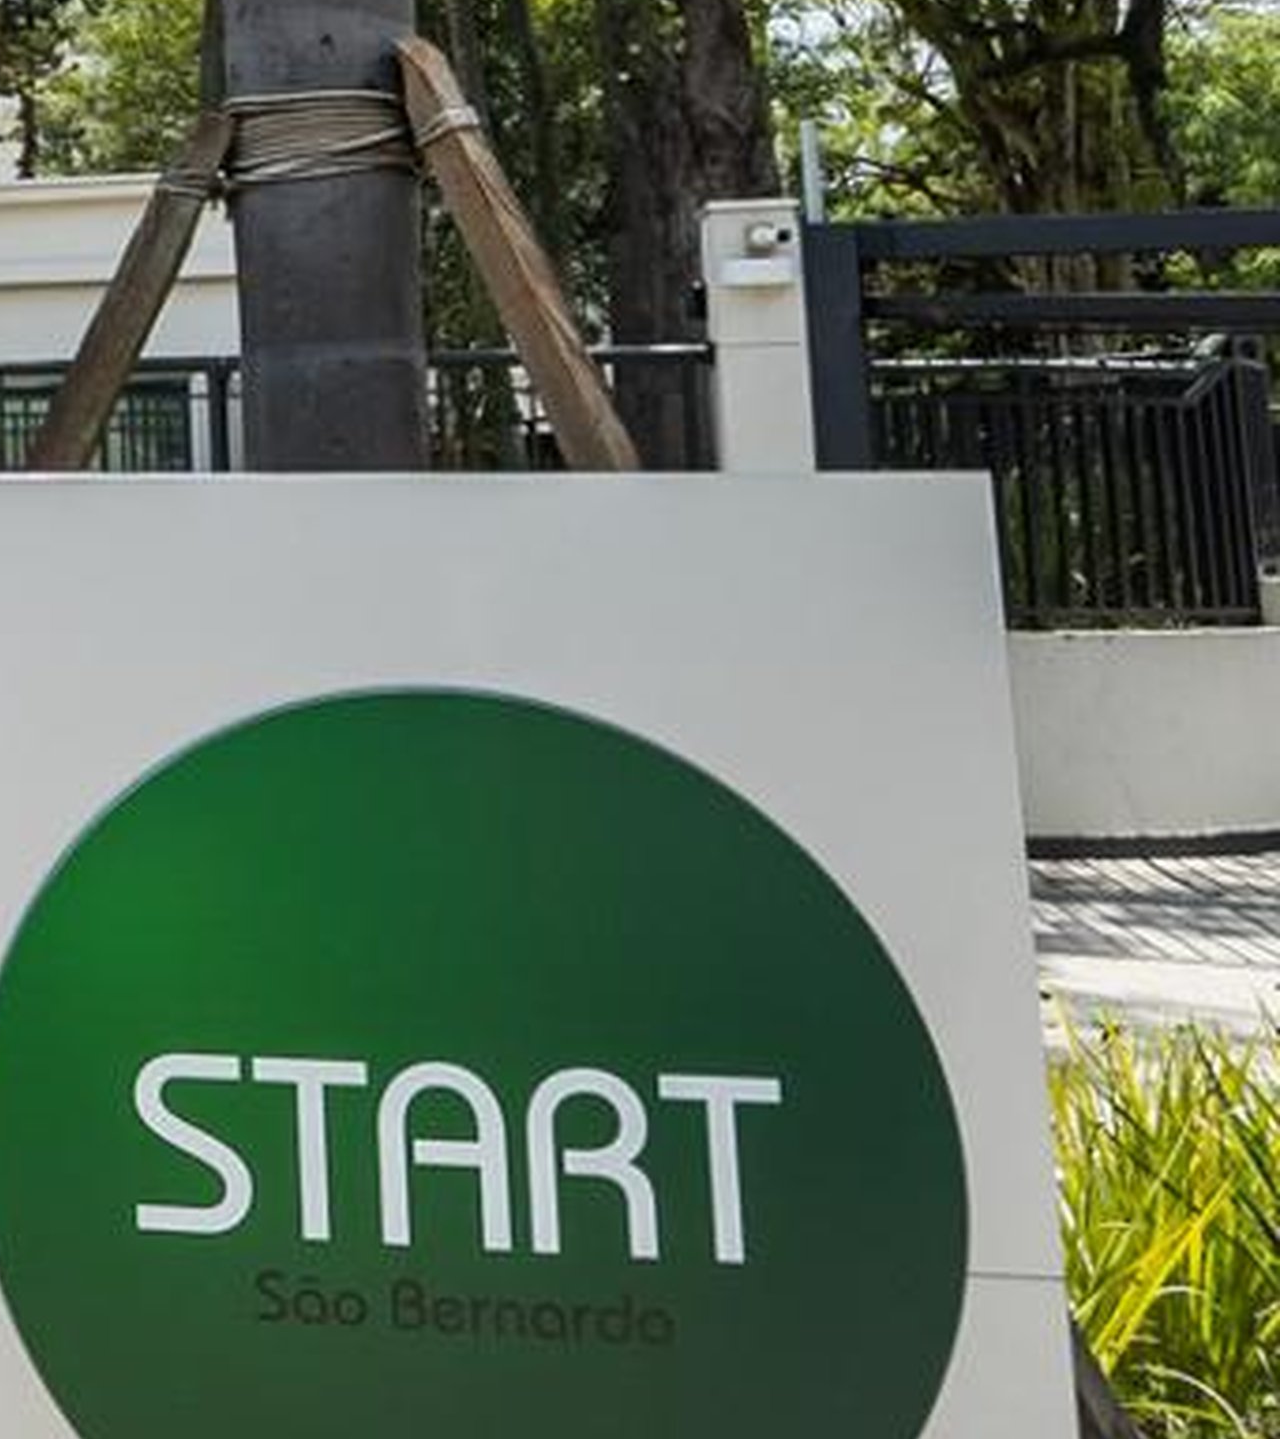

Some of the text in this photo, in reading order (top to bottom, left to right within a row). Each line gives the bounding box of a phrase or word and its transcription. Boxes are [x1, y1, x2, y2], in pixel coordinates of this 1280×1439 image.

[133, 1052, 782, 1264] START
[255, 1268, 677, 1346] São Bernardo
